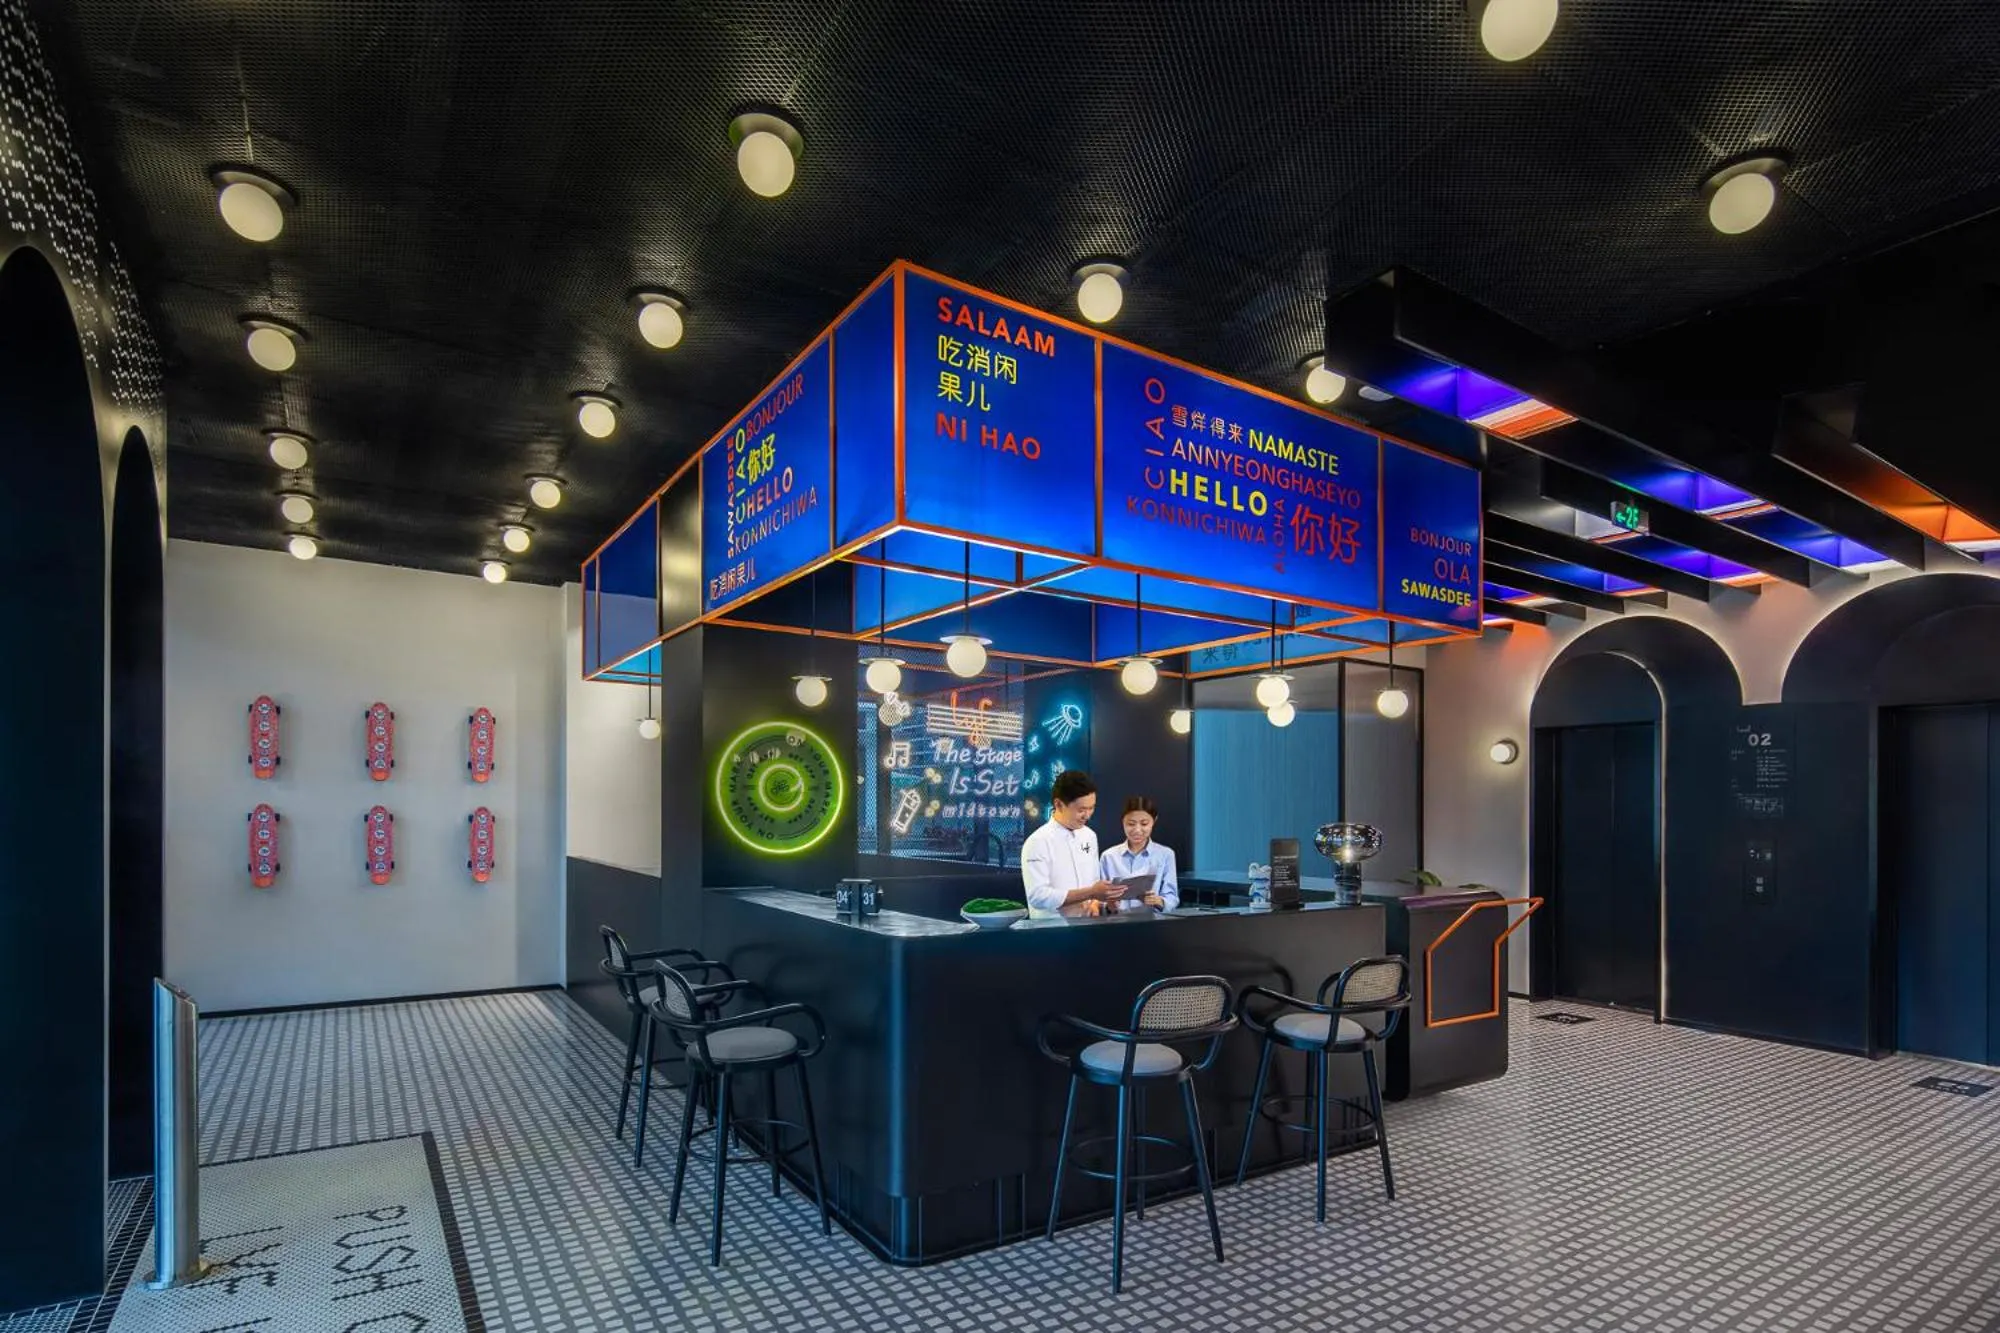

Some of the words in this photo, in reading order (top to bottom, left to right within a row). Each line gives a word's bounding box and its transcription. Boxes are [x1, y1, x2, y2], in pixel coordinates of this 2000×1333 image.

[937, 297, 1056, 357] SALAAM
[937, 335, 1018, 384] 吃消闲
[746, 373, 804, 440] BONJOUR
[937, 371, 991, 411] 果儿
[936, 412, 967, 442] NI
[981, 424, 1041, 460] HAO
[1144, 378, 1165, 489] CIAO
[1249, 429, 1340, 475] NAMASTE
[735, 428, 746, 524] CIAO
[748, 433, 776, 485] 你好
[1171, 437, 1361, 509] ANNYEONGHASEYO
[747, 466, 793, 522] HELLO
[1170, 468, 1268, 516] HELLO
[735, 486, 818, 552] KONNICHIWA
[1127, 495, 1267, 545] KONNICHIWA
[1273, 498, 1285, 574] ALOHA
[1291, 504, 1361, 564] 你好
[1410, 527, 1472, 557] BONJOUR
[1401, 578, 1472, 607] SAWASDEE
[1434, 557, 1471, 587] OLA
[931, 738, 971, 764] The
[974, 747, 1023, 766] Stage
[1748, 733, 1771, 746] 02
[950, 767, 971, 795] Is
[974, 770, 1020, 796] Set
[942, 801, 1021, 818] midtown
[836, 890, 849, 904] 04
[863, 892, 875, 905] 31
[331, 1204, 423, 1301] PUSH
